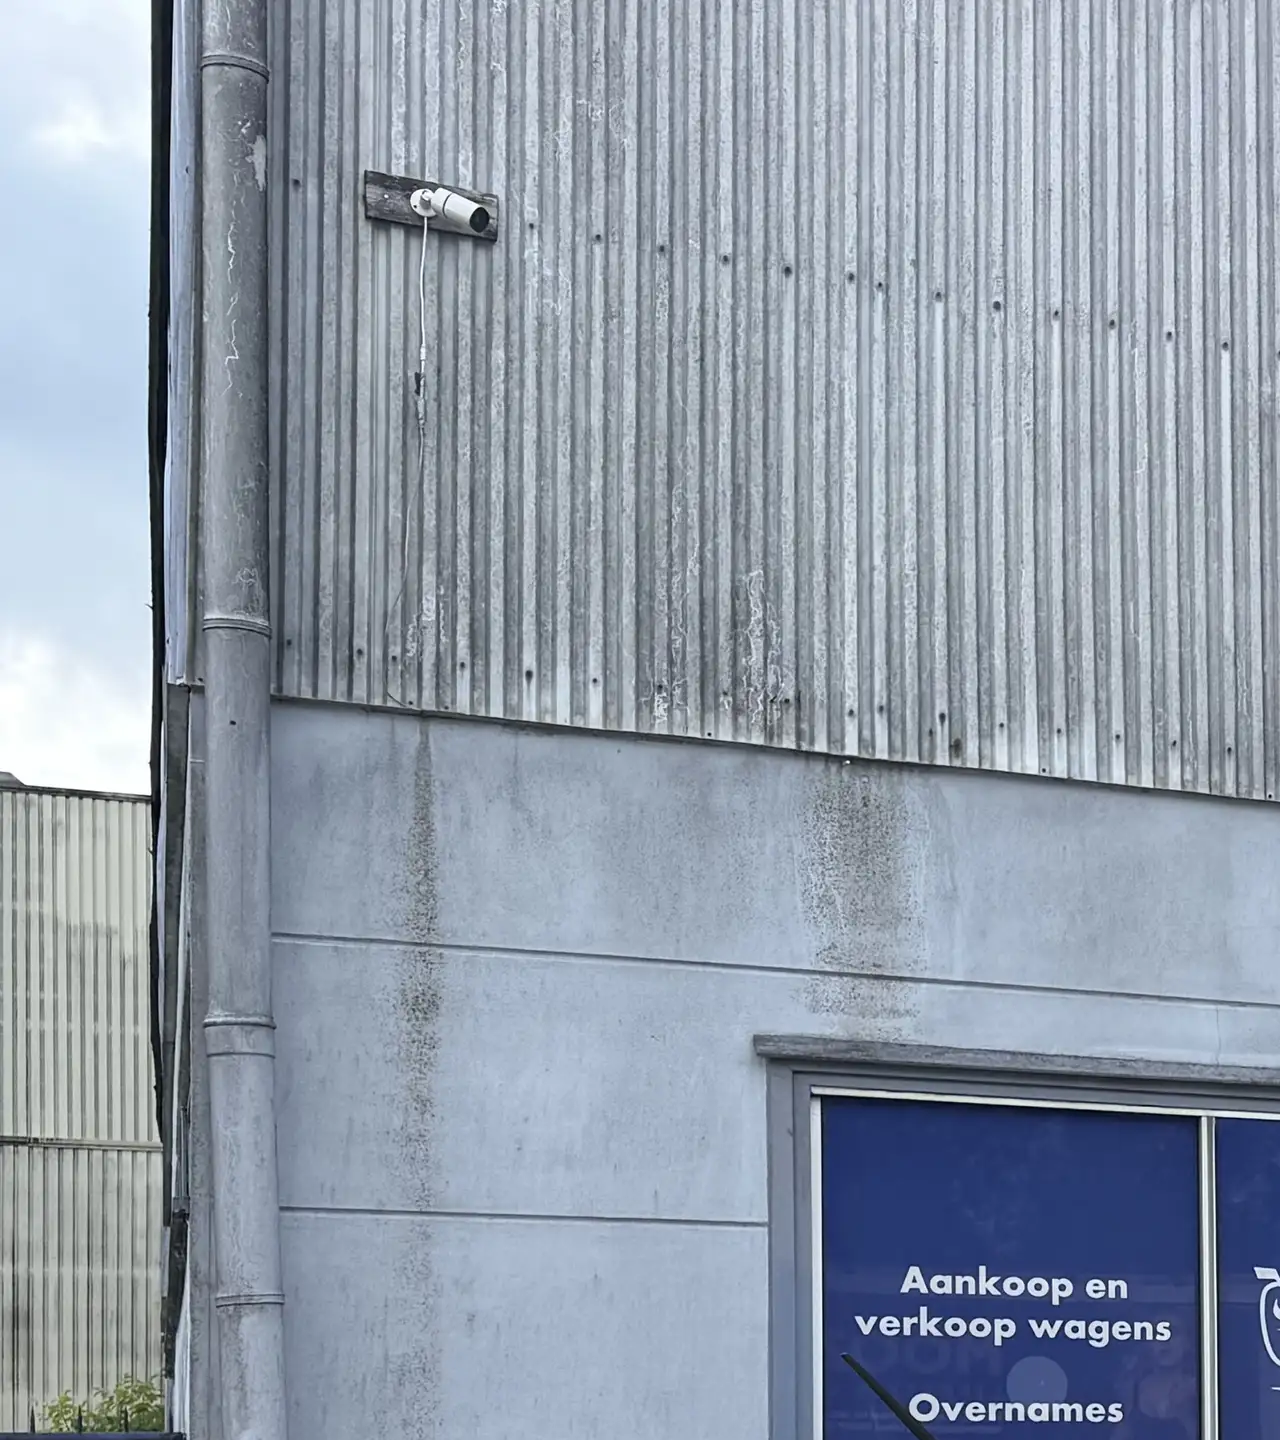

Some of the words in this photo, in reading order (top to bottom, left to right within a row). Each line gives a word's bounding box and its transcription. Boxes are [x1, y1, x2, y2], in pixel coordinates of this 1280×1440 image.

[899, 1265, 1074, 1305] Aankoop
[1085, 1278, 1128, 1299] en
[854, 1306, 1017, 1347] verkoop
[1027, 1319, 1172, 1348] wagens
[908, 1392, 1124, 1423] Overnames
